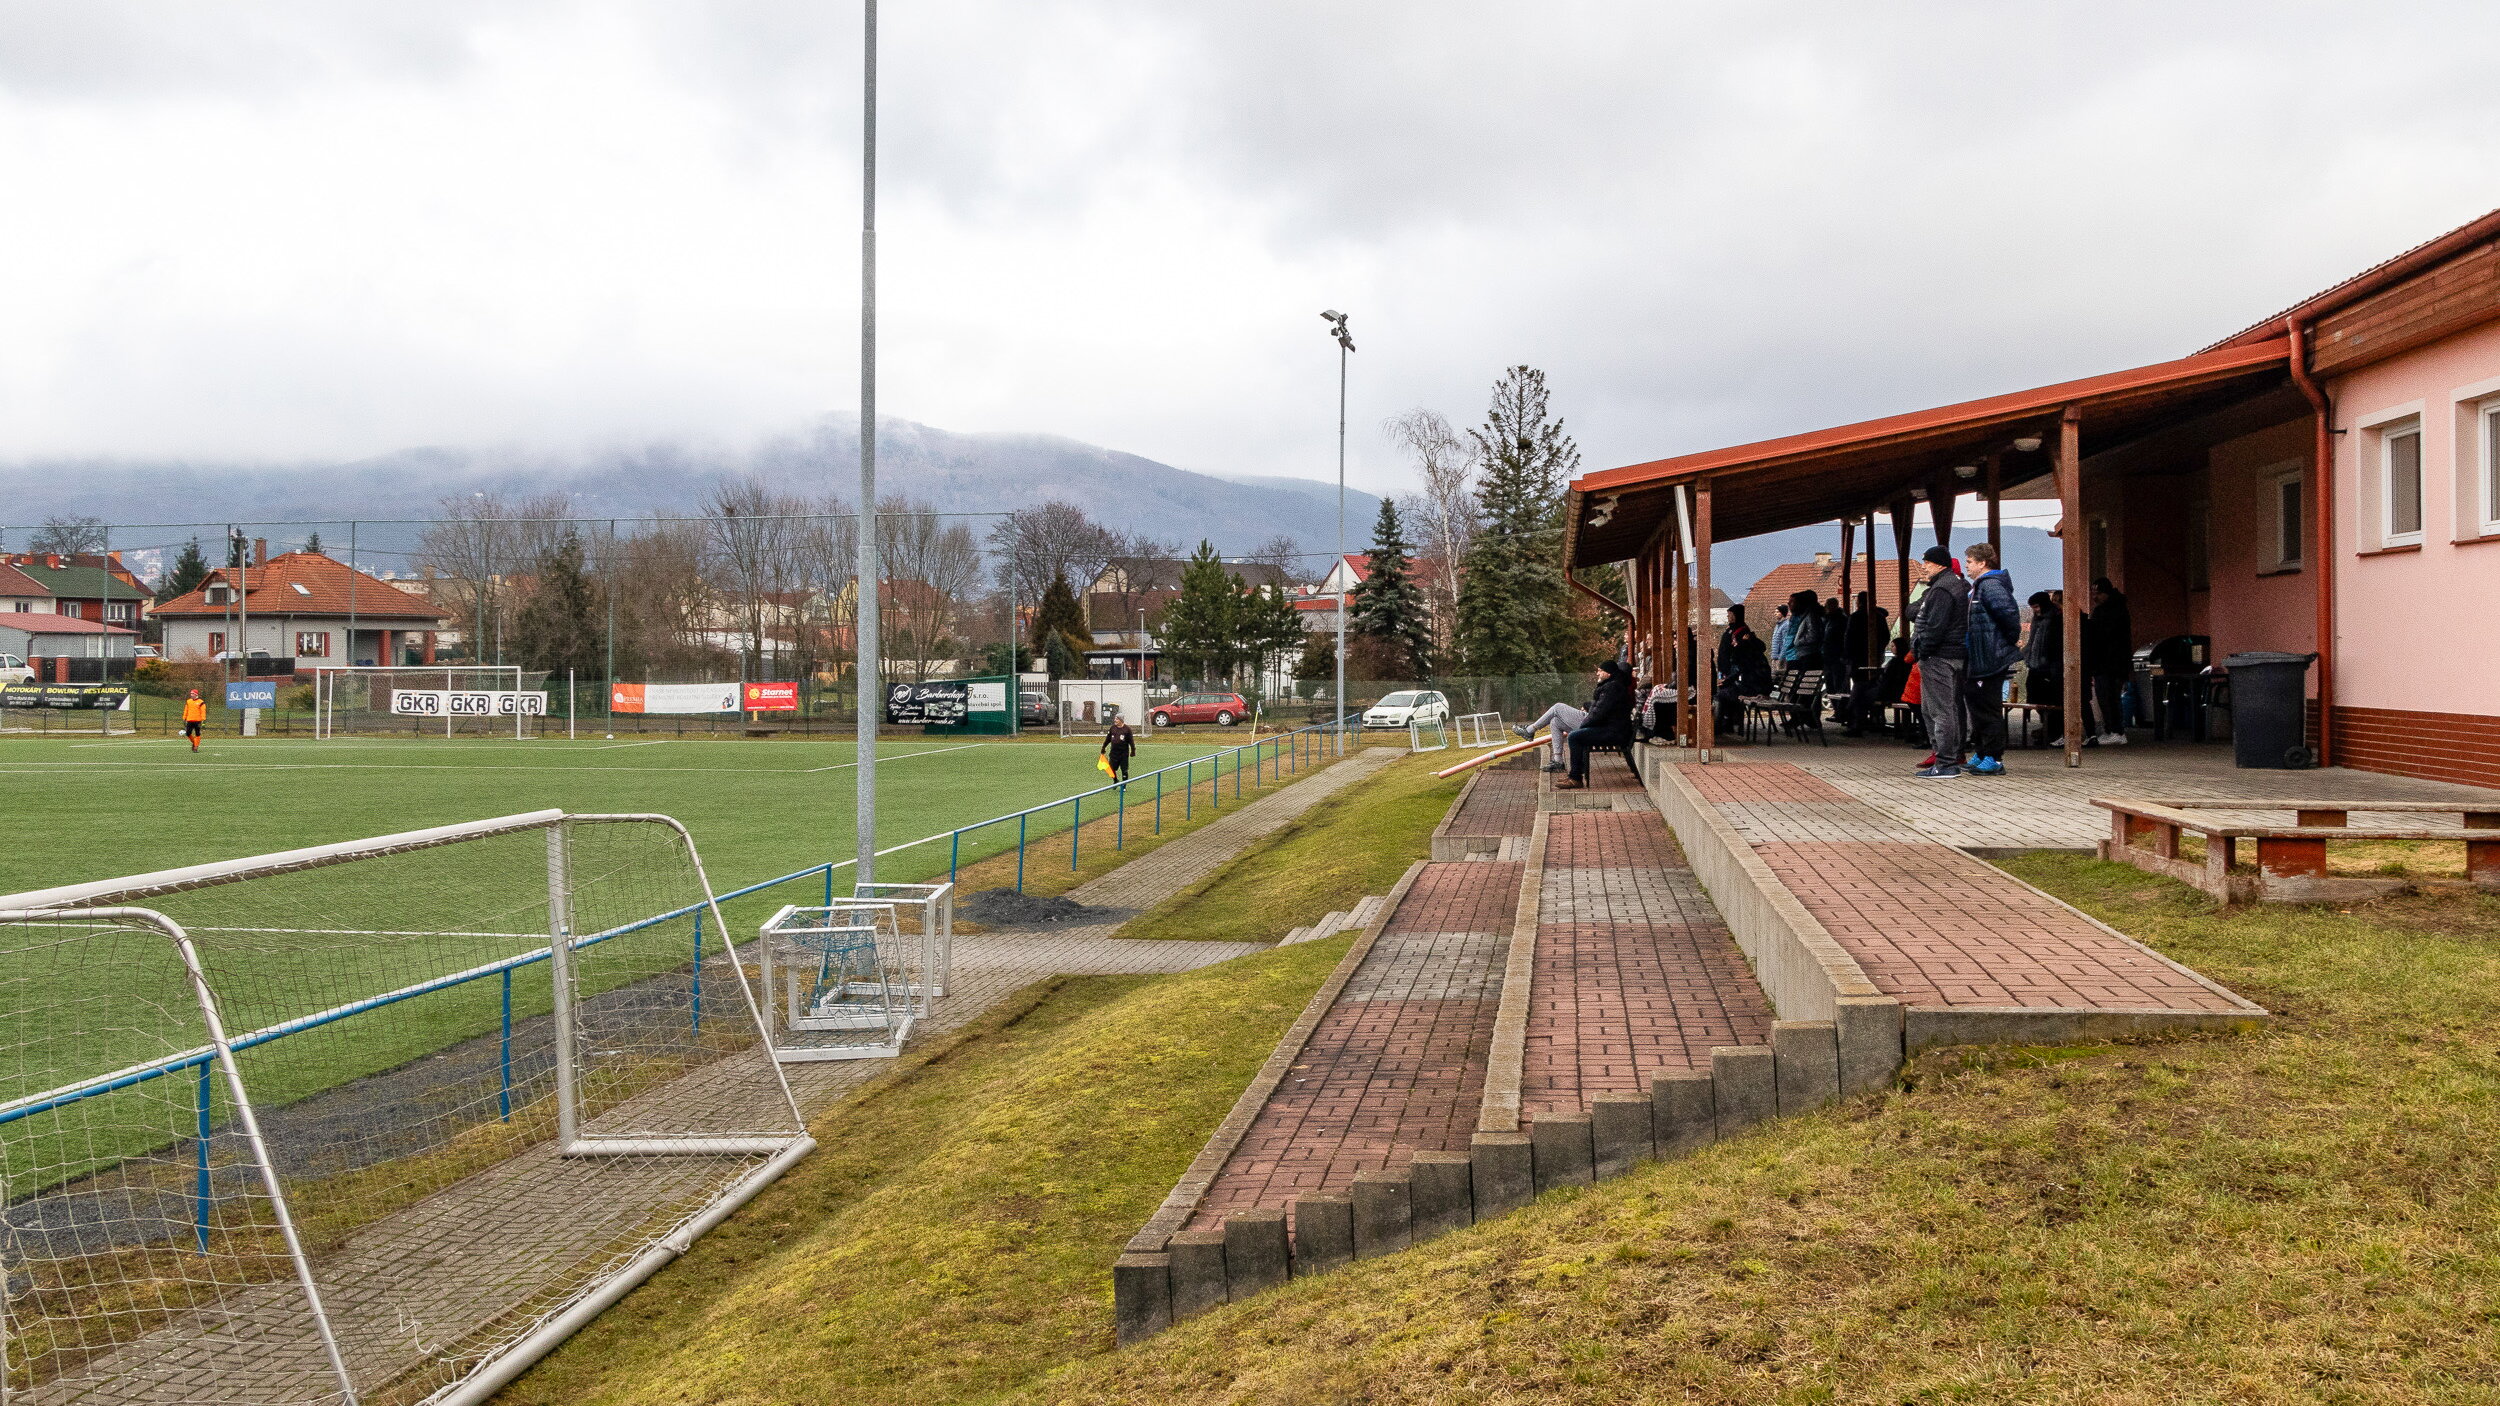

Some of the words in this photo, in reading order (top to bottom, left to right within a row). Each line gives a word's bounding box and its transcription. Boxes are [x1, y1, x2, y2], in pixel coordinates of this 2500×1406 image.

[243, 691, 273, 700] UNIQA
[915, 689, 966, 702] Barbershop
[400, 696, 435, 711] GKR
[450, 697, 485, 712] GKR
[502, 698, 538, 713] GKR
